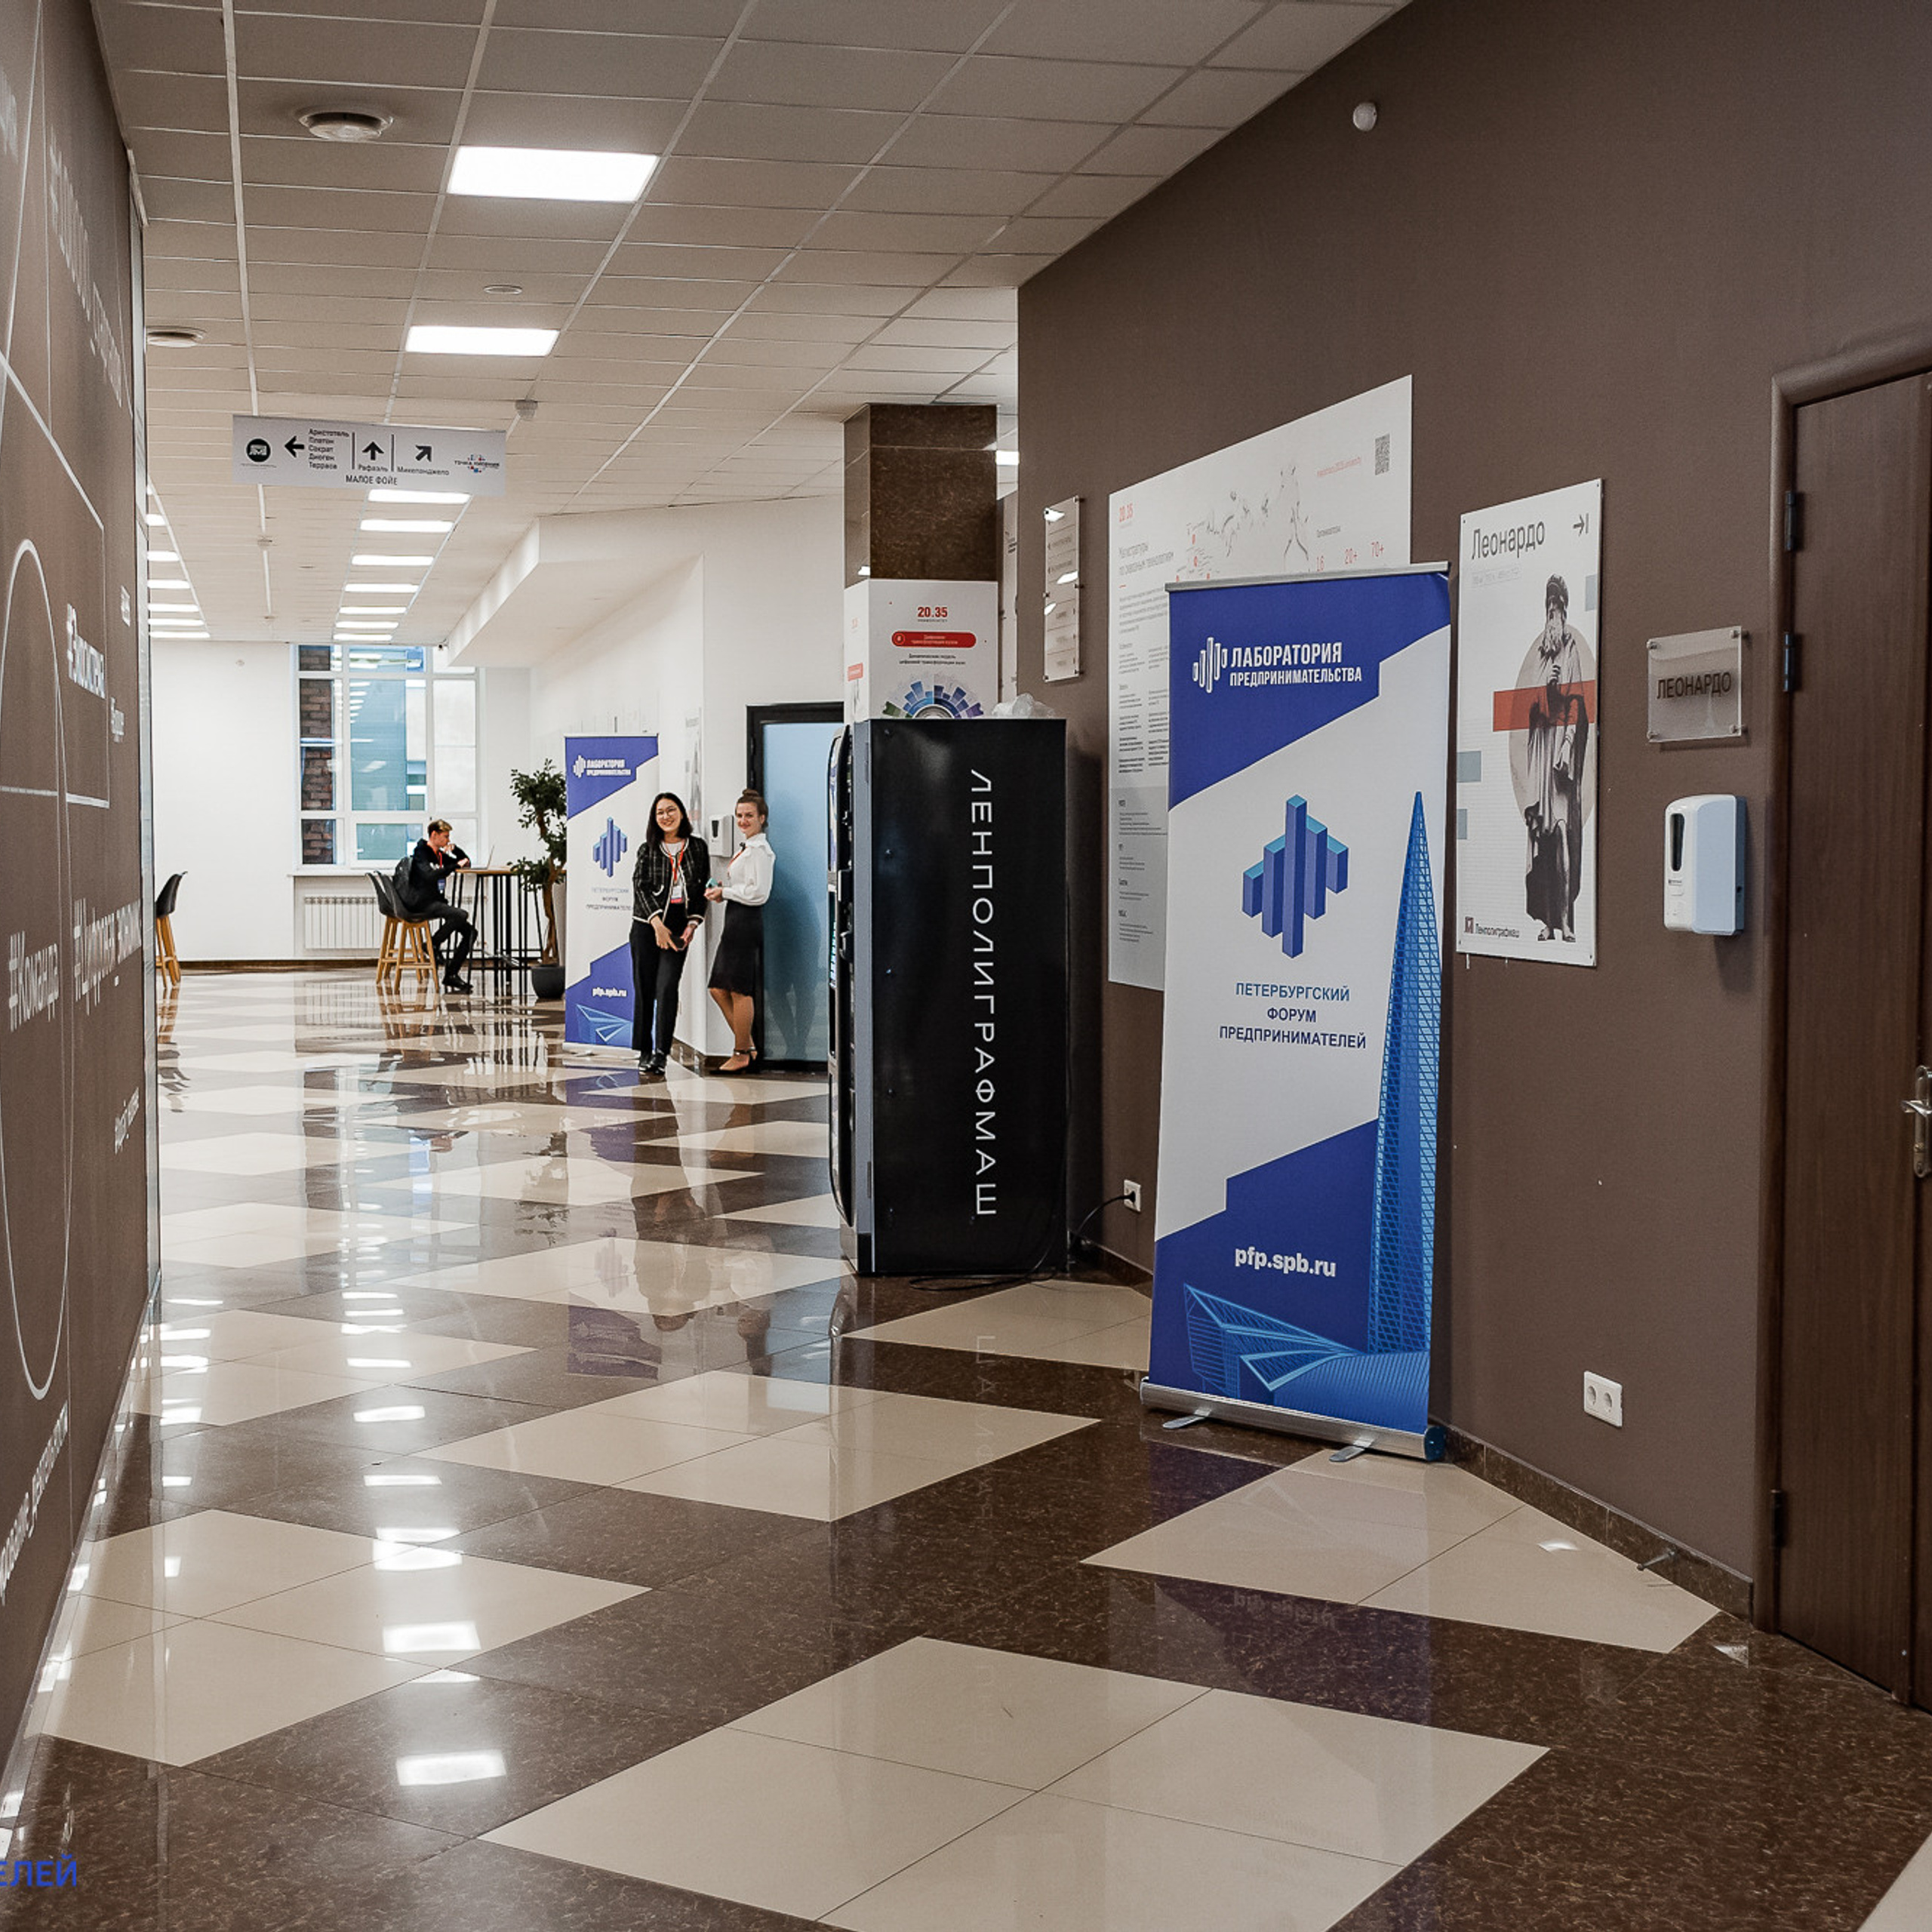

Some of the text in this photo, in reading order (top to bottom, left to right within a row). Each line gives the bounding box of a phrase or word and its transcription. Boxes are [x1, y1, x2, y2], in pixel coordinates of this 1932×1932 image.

[309, 428, 349, 438] Аристотель
[309, 445, 334, 453] Сократ
[309, 453, 335, 461] Диоген
[309, 461, 338, 469] Терраса
[358, 463, 389, 472] Рафаэль
[346, 475, 398, 485] МАЛОЕ ФОЙЕ
[1472, 521, 1546, 560] Леонардо
[917, 606, 948, 618] 20.35
[1230, 641, 1343, 668] ЛАБОРАТОРИЯ
[1229, 666, 1363, 688] ПРЕДПРИНИМАТЕЛЬСТВА
[1656, 671, 1733, 700] ЛЕОНАРДО
[971, 769, 996, 1216] ЛЕНПОЛИГРАФМАШ
[1235, 983, 1350, 1001] ПЕТЕРБУРГСКИЙ
[1267, 1007, 1317, 1023] ФОРУМ
[1220, 1026, 1367, 1049] ПРЕДПРИНИМАТЕЛЕЙ
[1235, 1246, 1337, 1278] pfp.spb.ru
